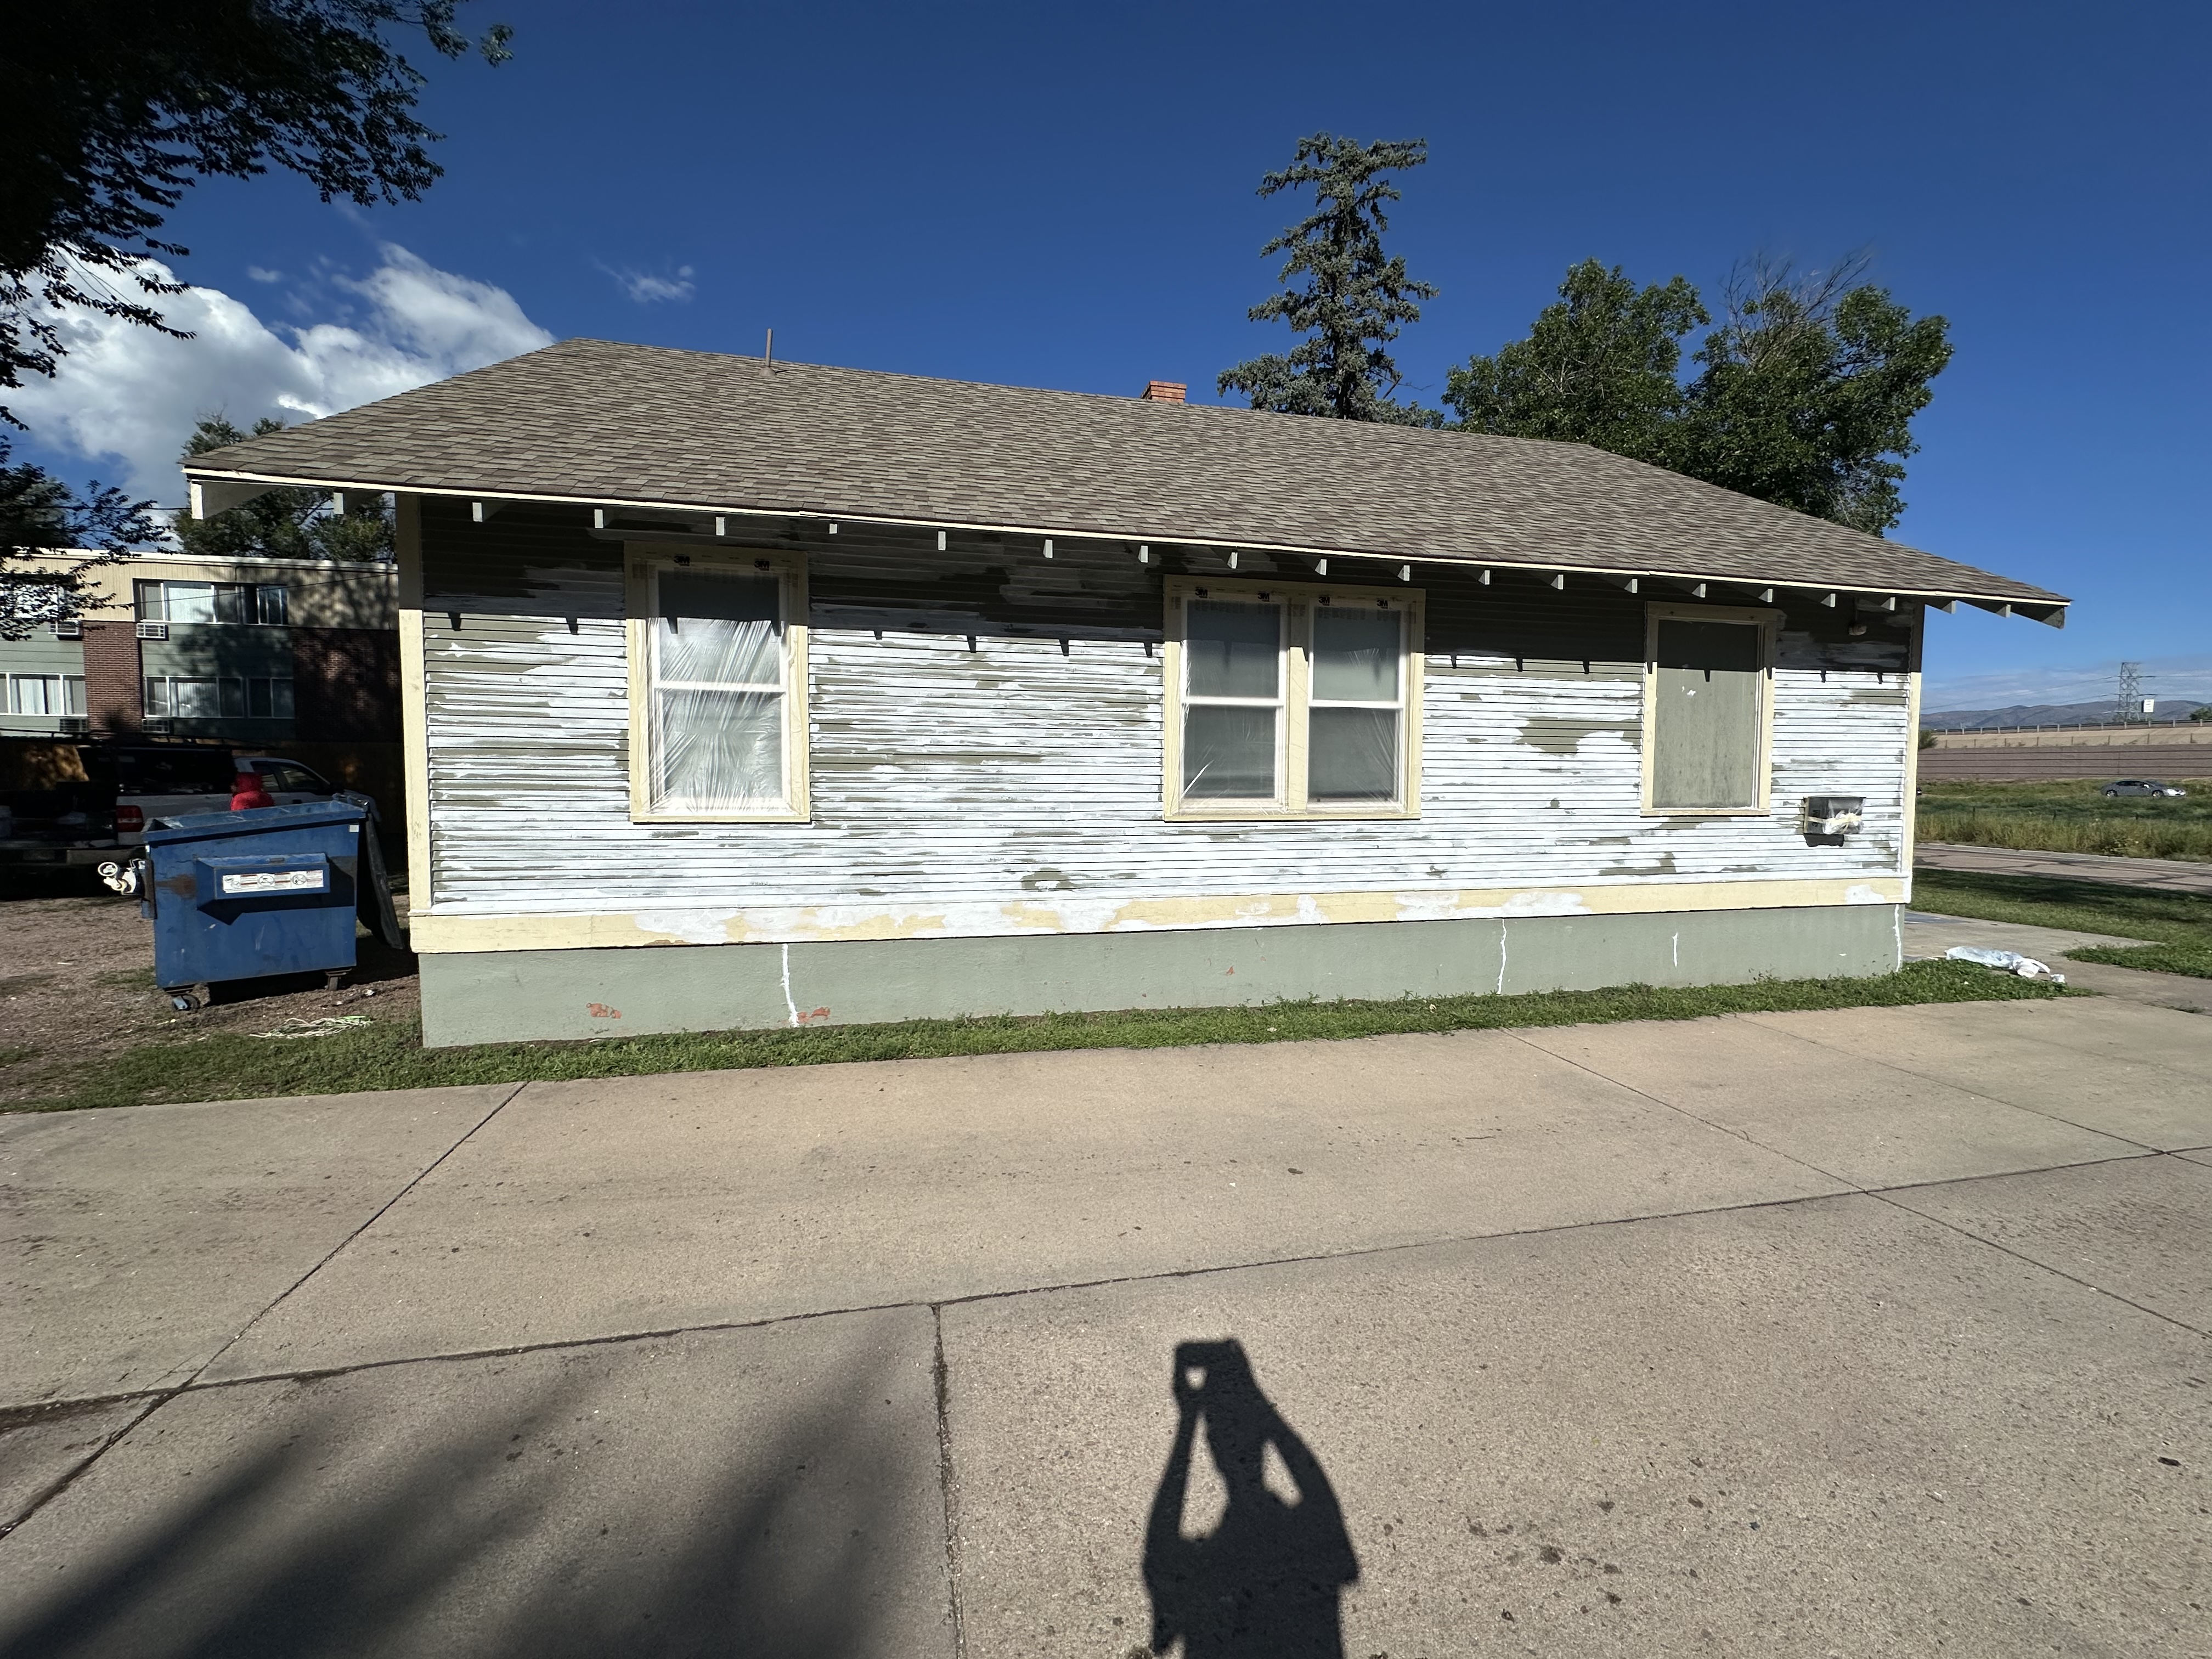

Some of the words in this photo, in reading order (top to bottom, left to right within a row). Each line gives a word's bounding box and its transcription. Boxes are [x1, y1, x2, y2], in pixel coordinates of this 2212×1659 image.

[674, 556, 690, 564] 3M
[754, 560, 770, 568] 3M
[1195, 589, 1208, 597] 3M
